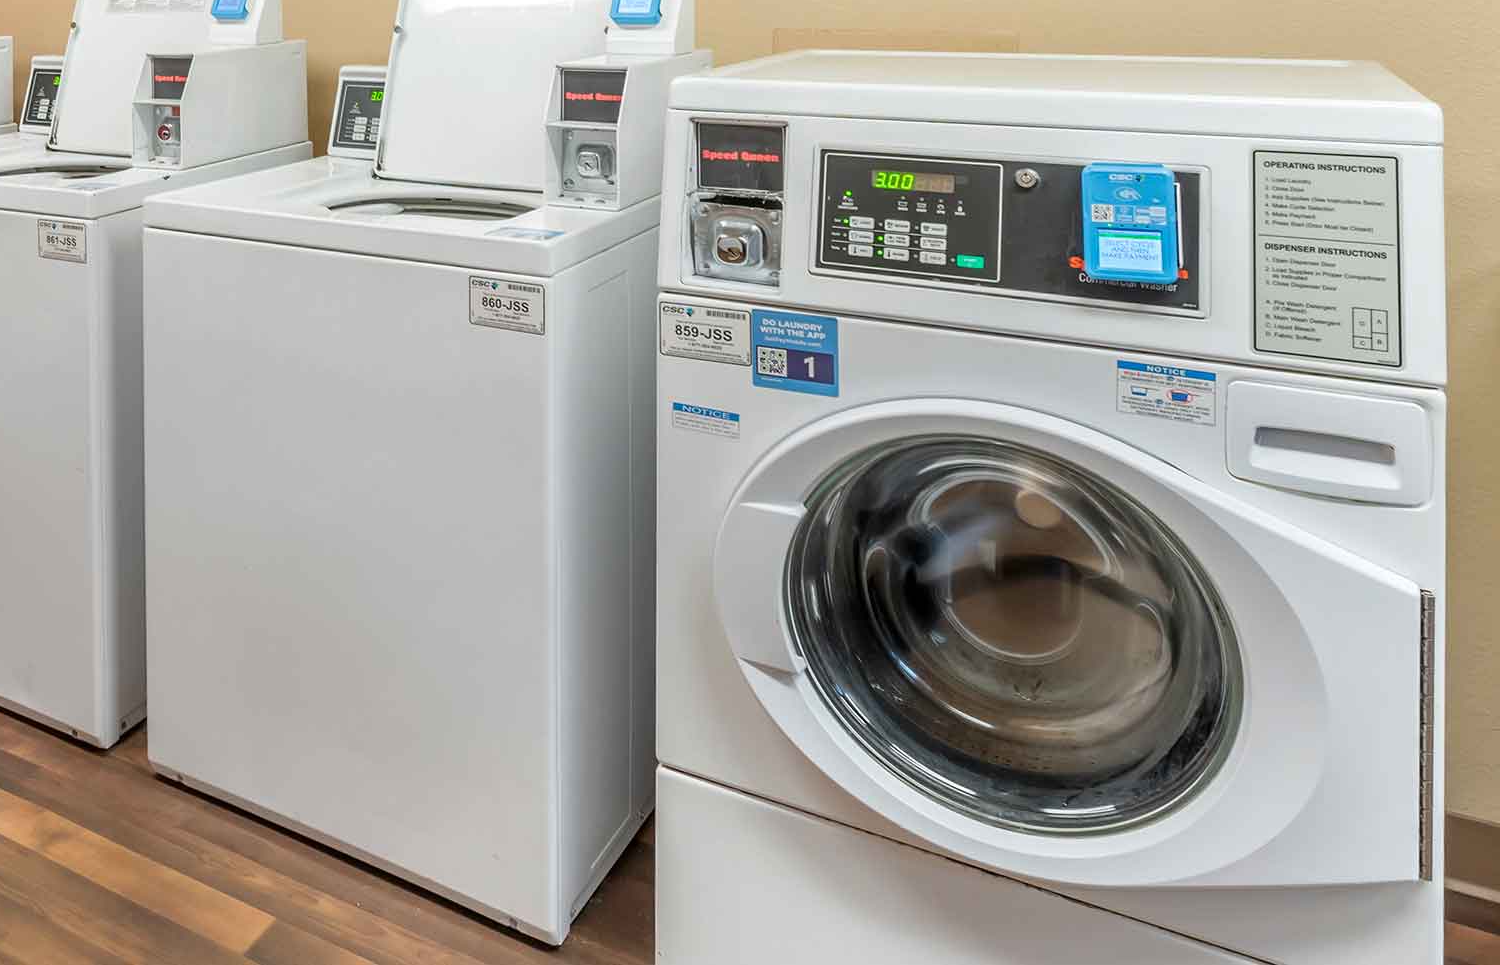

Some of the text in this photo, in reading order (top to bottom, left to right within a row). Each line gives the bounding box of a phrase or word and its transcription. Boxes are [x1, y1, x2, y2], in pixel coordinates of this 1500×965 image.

[702, 148, 780, 163] Speed Queen
[1263, 160, 1387, 175] OPERATING INSTRUCTIONS
[875, 171, 915, 190] 3.00
[1108, 174, 1133, 182] CSC
[46, 236, 77, 247] 861-JSS
[1264, 242, 1388, 259] DISPENSER INSTRUCTIONS
[472, 279, 490, 288] CSC
[482, 296, 530, 313] 860-JSS
[662, 305, 685, 316] CSC
[760, 325, 785, 335] WITH
[787, 329, 805, 339] THE
[762, 318, 823, 331] DO LAUNDRY
[675, 324, 733, 342] 859-JSS
[803, 356, 815, 378] 1
[1146, 365, 1187, 376] NOTICE
[681, 404, 732, 420] NOTICE
